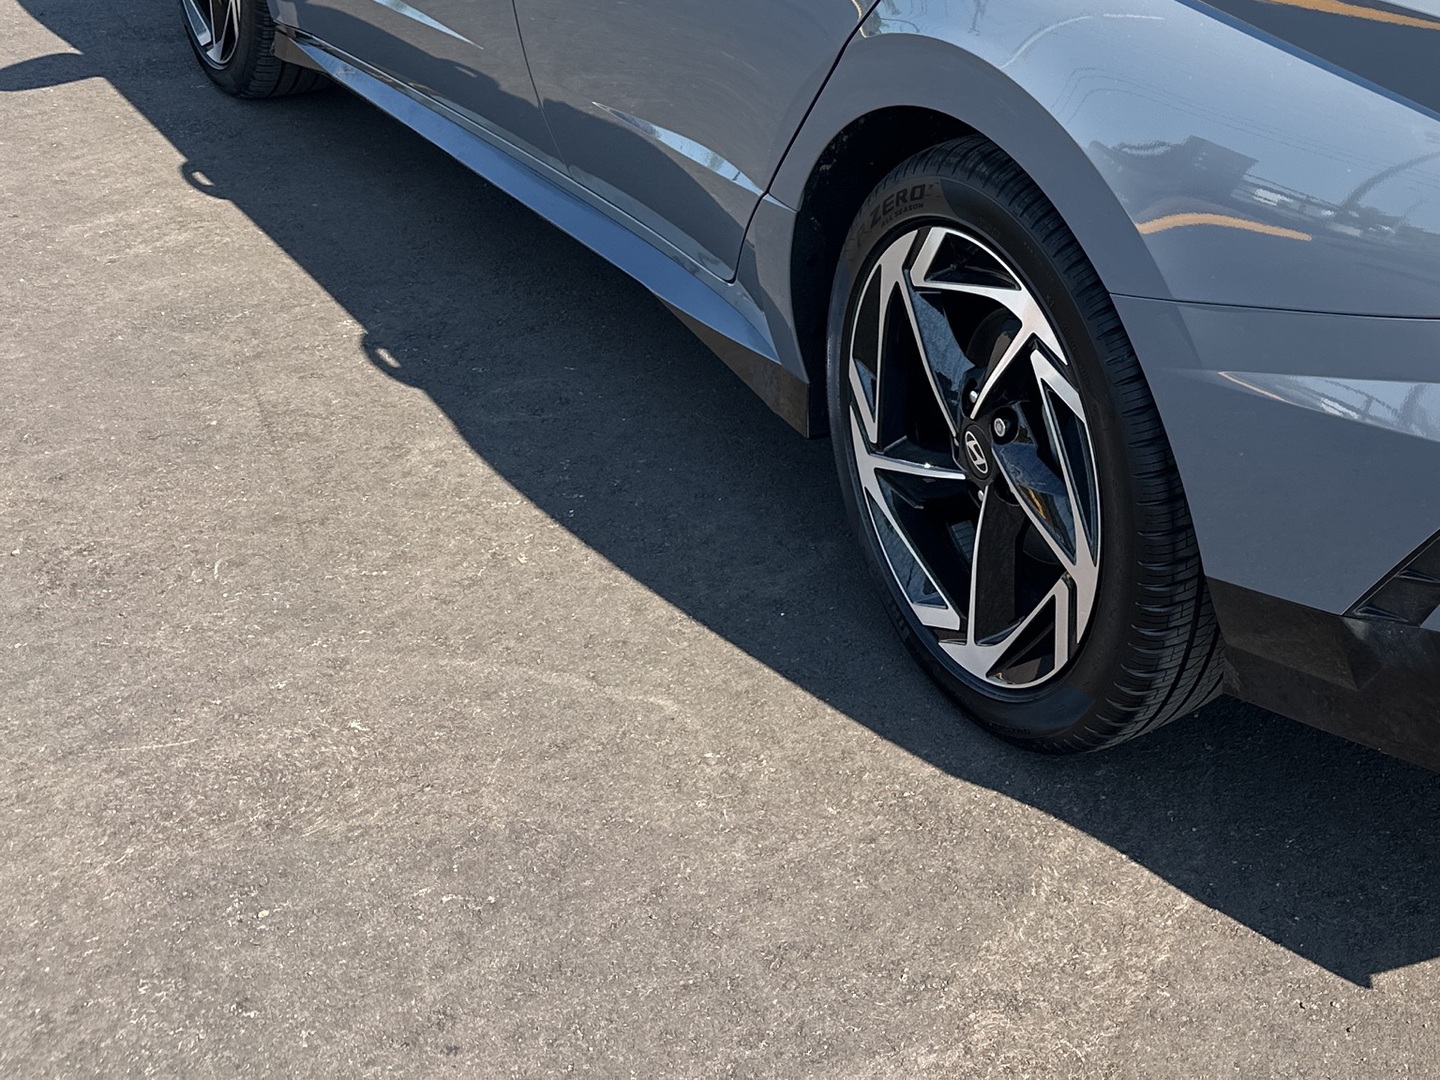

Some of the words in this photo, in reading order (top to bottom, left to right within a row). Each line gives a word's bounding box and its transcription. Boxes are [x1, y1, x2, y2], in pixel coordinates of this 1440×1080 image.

[870, 184, 926, 229] ZERO
[881, 215, 893, 228] ALL
[894, 202, 925, 218] SEASON
